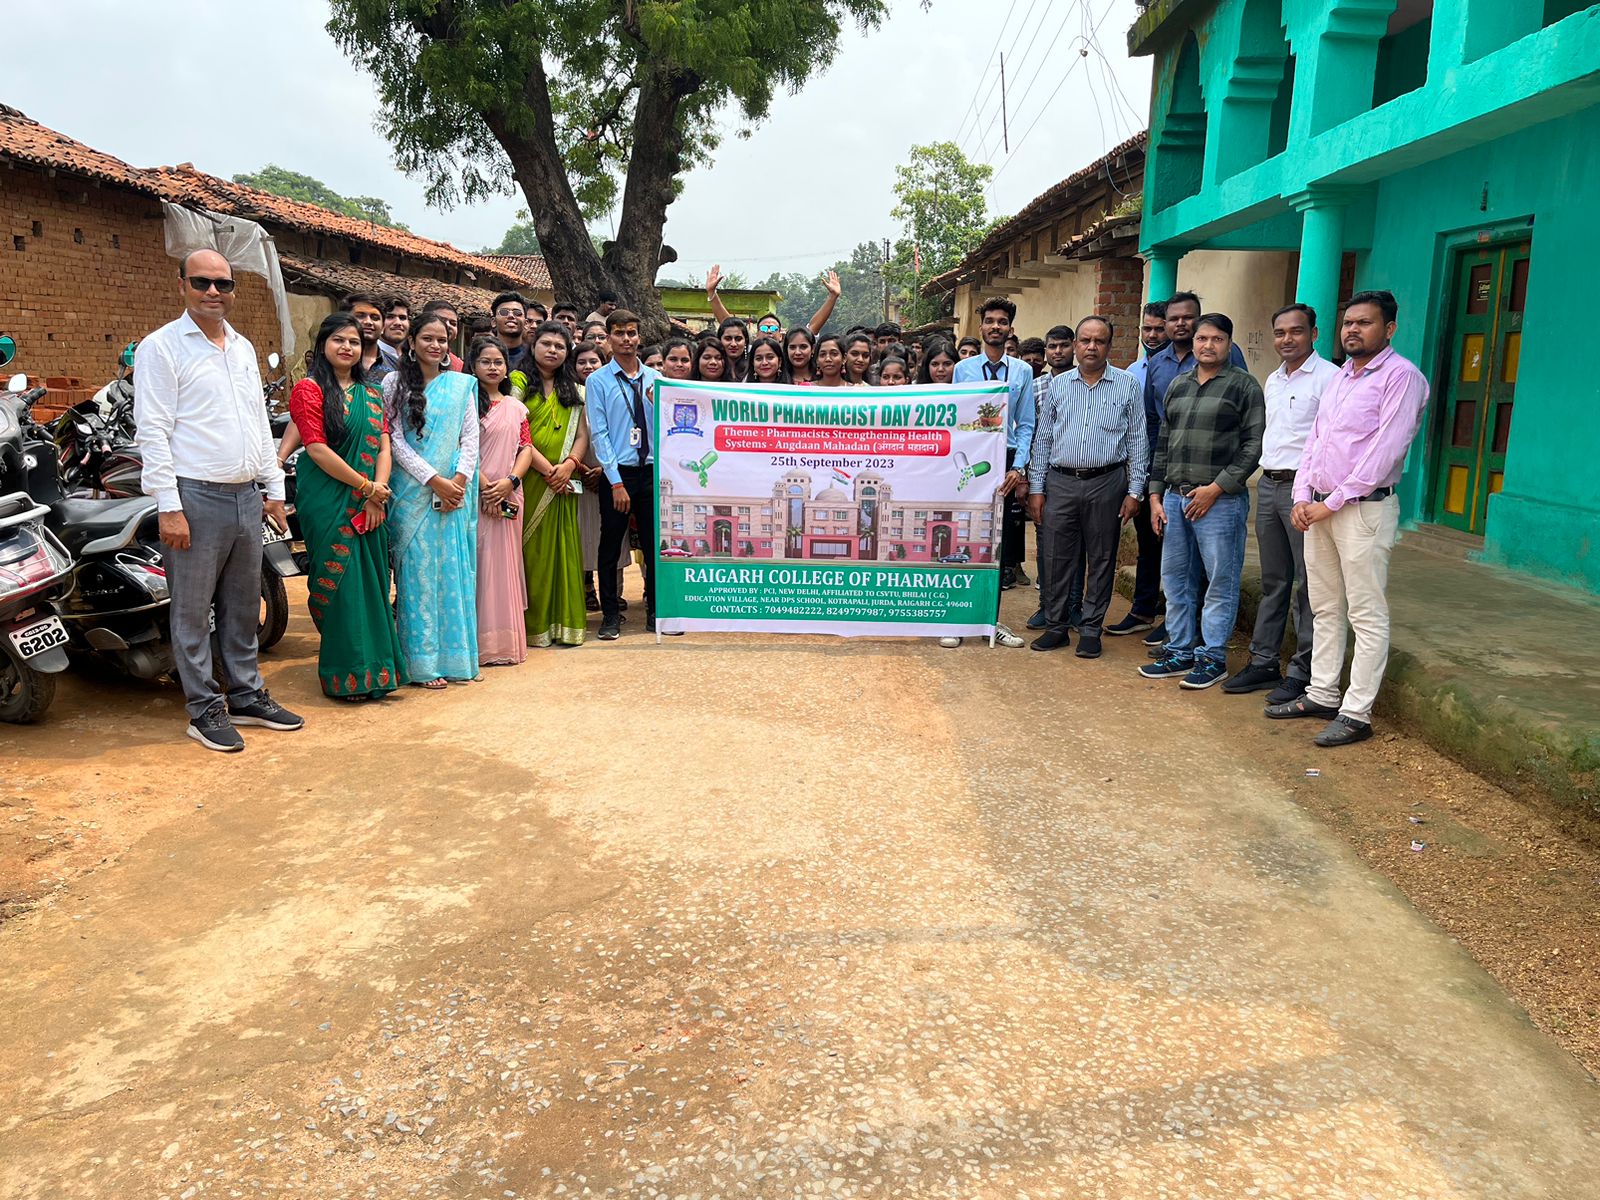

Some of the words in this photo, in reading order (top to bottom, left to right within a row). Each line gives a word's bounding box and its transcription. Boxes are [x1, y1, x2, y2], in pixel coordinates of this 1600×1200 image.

[711, 399, 769, 422] WORLD
[773, 402, 877, 426] PHARMACIST
[881, 404, 911, 427] DAY
[914, 403, 957, 427] 2023
[723, 427, 758, 437] Theme
[767, 427, 830, 439] Pharmacists
[832, 430, 905, 442] Strengthening
[908, 431, 942, 441] Health
[725, 439, 767, 449] Systems
[775, 440, 820, 451] Angdaan
[823, 441, 870, 451] Mahadan
[771, 456, 797, 466] 25th
[800, 457, 862, 469] September
[865, 458, 894, 468] 2023
[684, 568, 764, 584] RAIGARH
[769, 570, 844, 586] COLLEGE
[849, 572, 871, 587] OF
[876, 573, 974, 588] PHARMACY
[710, 605, 758, 614] CONTACTS
[888, 609, 946, 617] 9755385757
[19, 628, 67, 656] 6202
